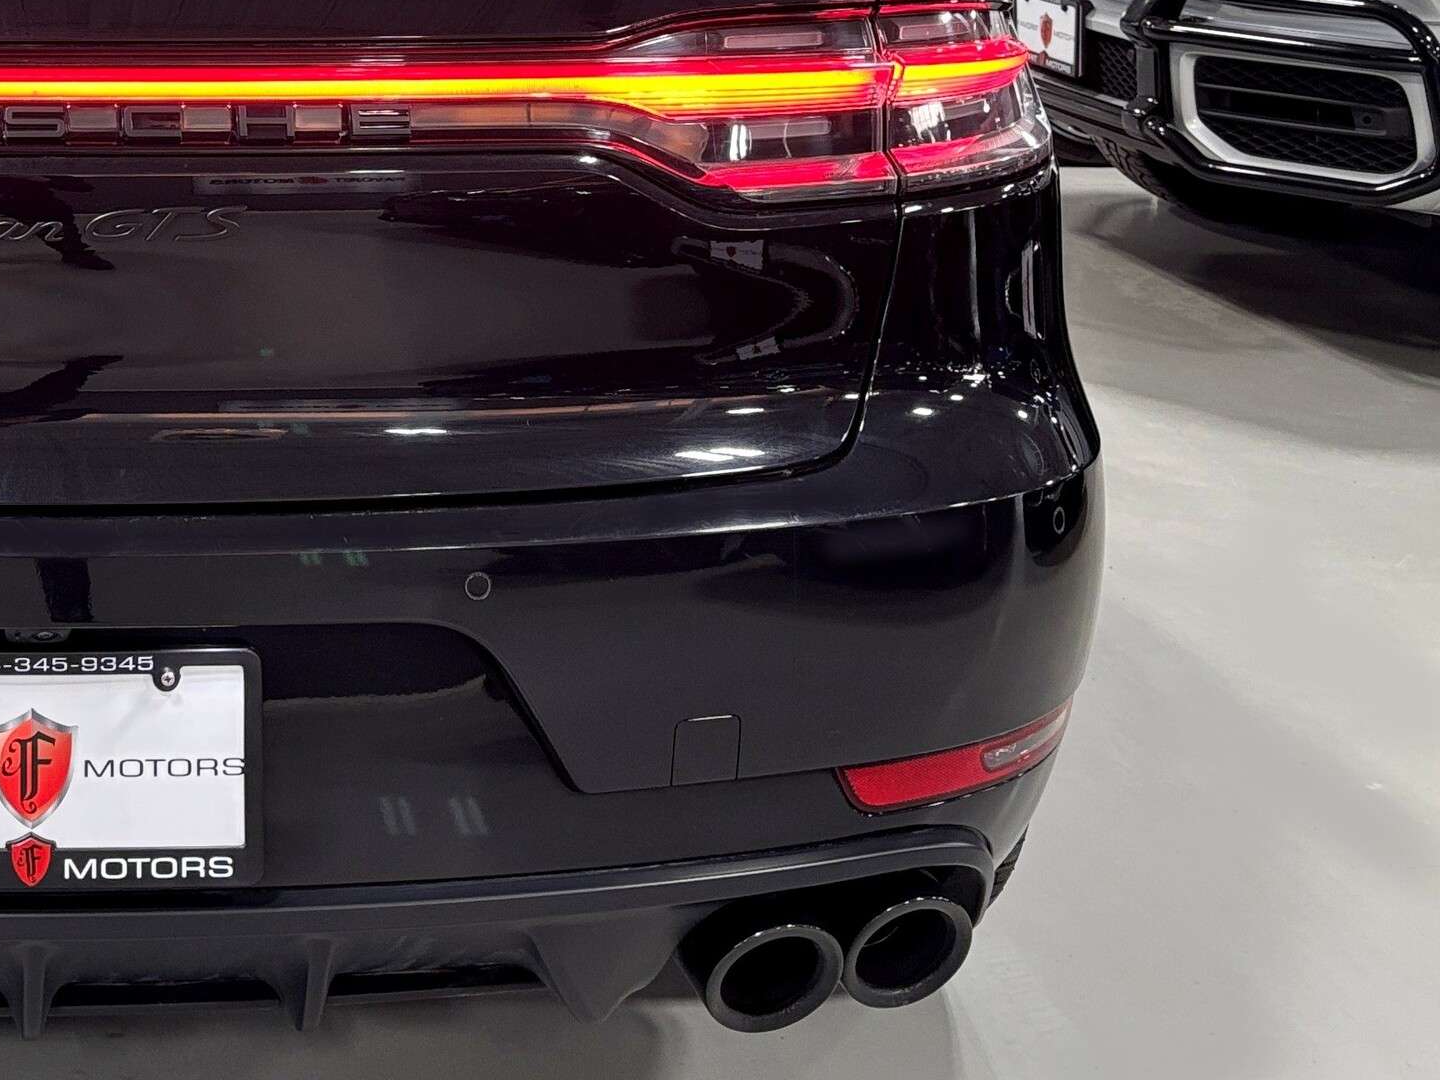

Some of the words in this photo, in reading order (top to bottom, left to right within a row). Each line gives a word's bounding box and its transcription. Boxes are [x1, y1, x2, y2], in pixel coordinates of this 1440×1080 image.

[86, 206, 247, 241] GTS
[84, 757, 247, 778] MOTORS
[64, 857, 234, 880] MOTORS
